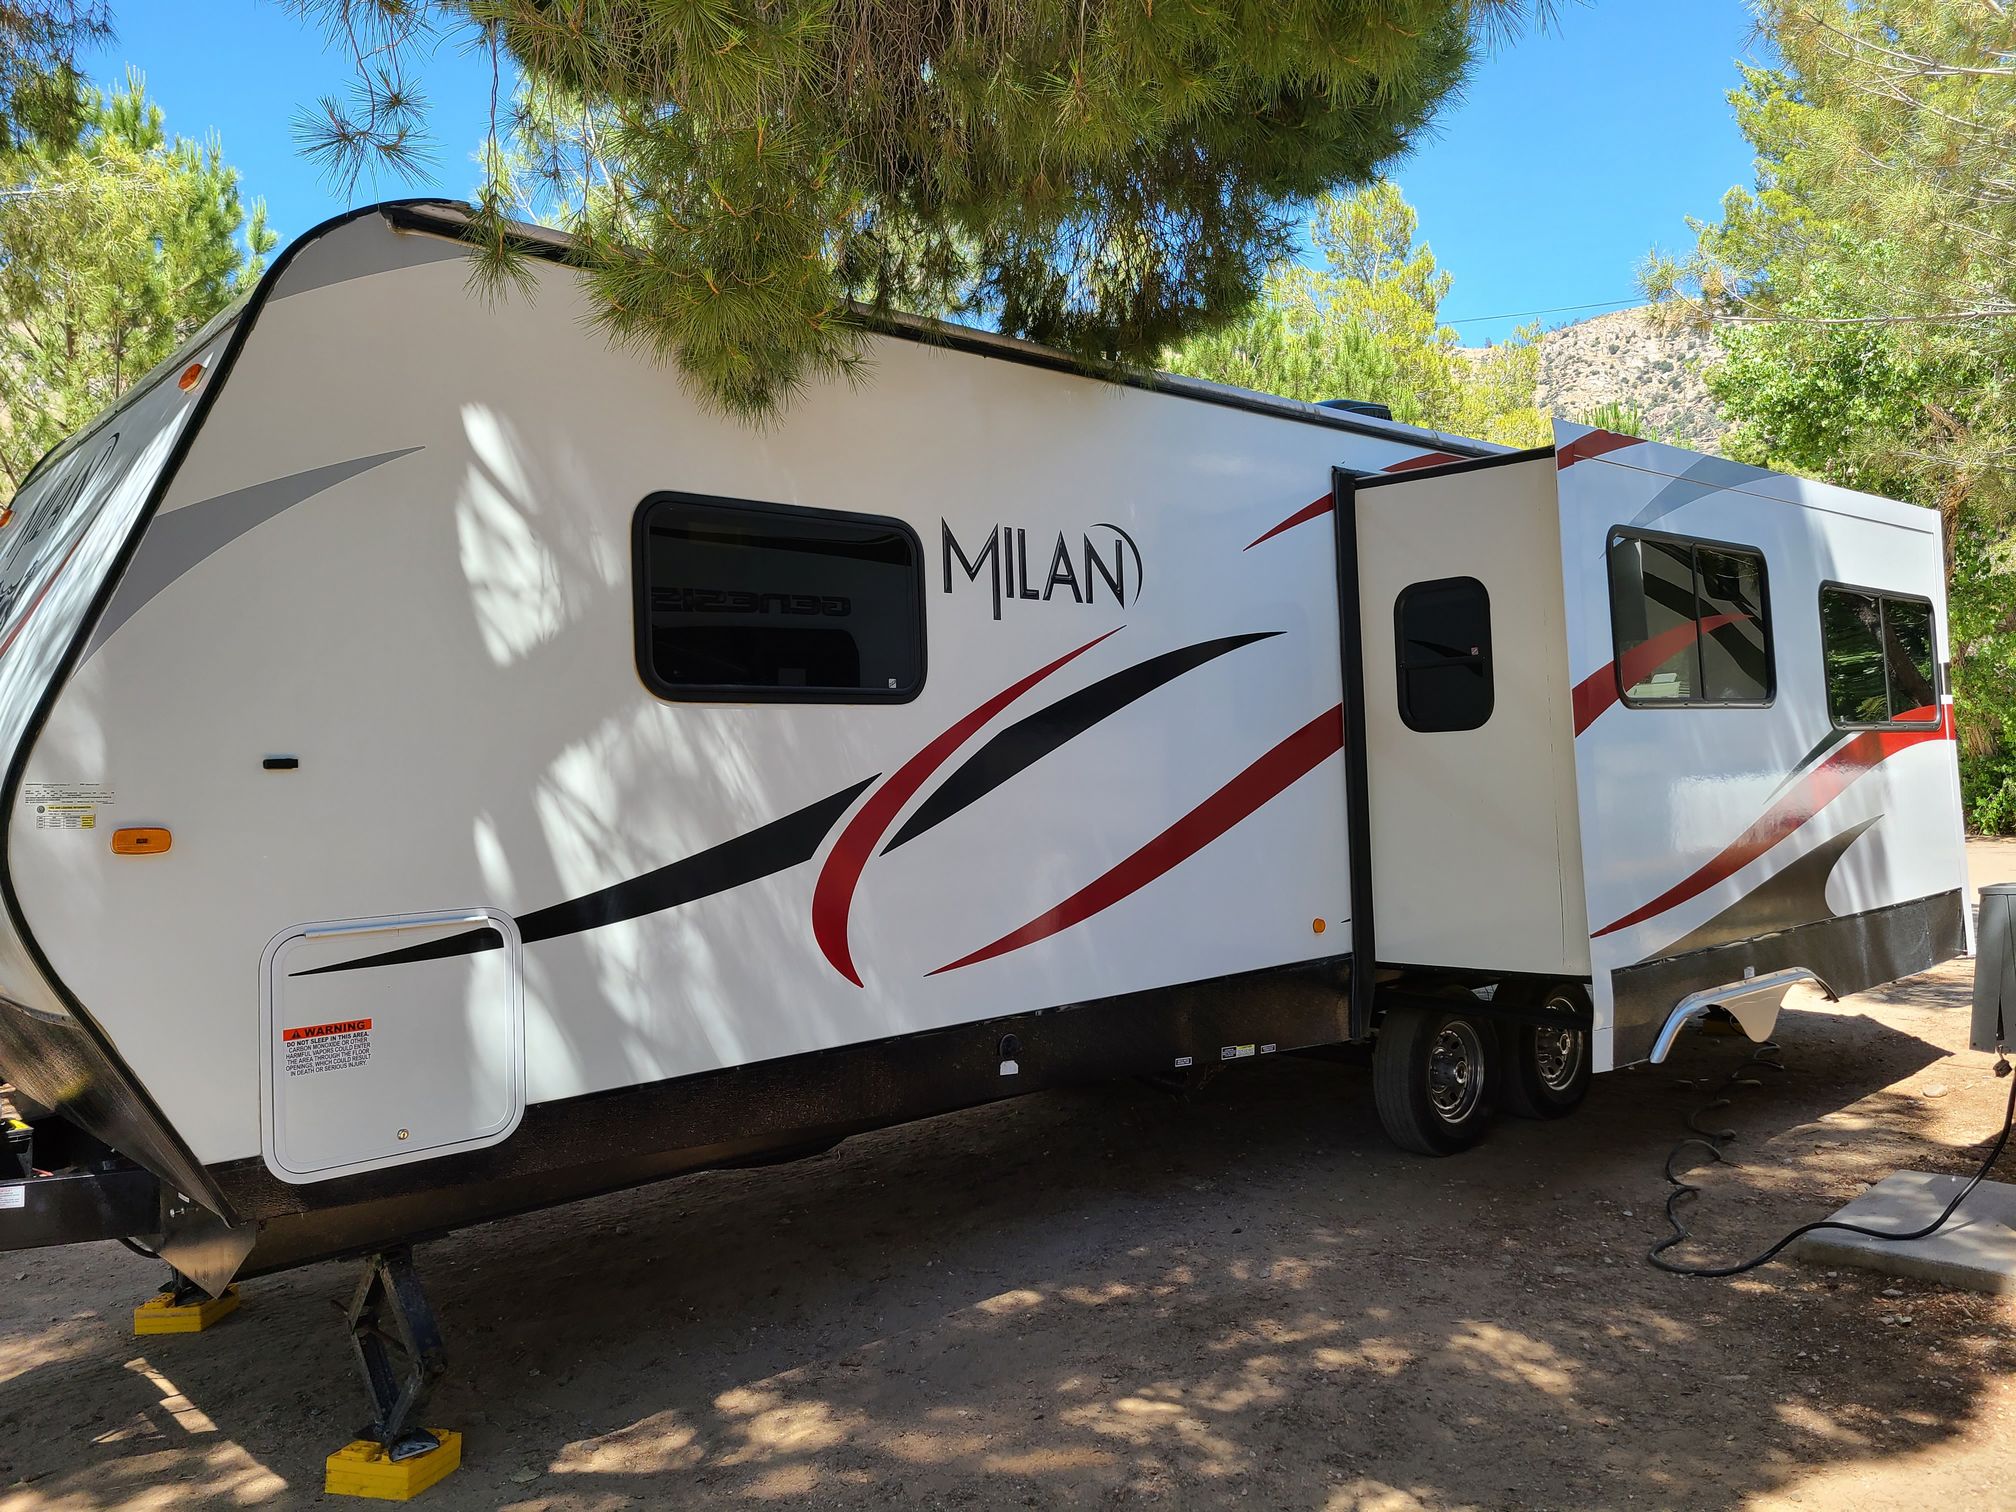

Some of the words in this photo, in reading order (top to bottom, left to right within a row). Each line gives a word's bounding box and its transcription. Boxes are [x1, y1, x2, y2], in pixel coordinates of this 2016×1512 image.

[941, 516, 1125, 621] MILAN
[305, 1021, 365, 1037] WARNING
[289, 1045, 311, 1053] CARBON
[313, 1041, 340, 1049] MONOXIDE
[313, 1048, 334, 1056] VAPORS
[315, 1053, 340, 1061] THROUGH
[315, 1059, 332, 1067] WHICH
[297, 1068, 315, 1076] DEATH
[324, 1063, 347, 1072] SERIOUS
